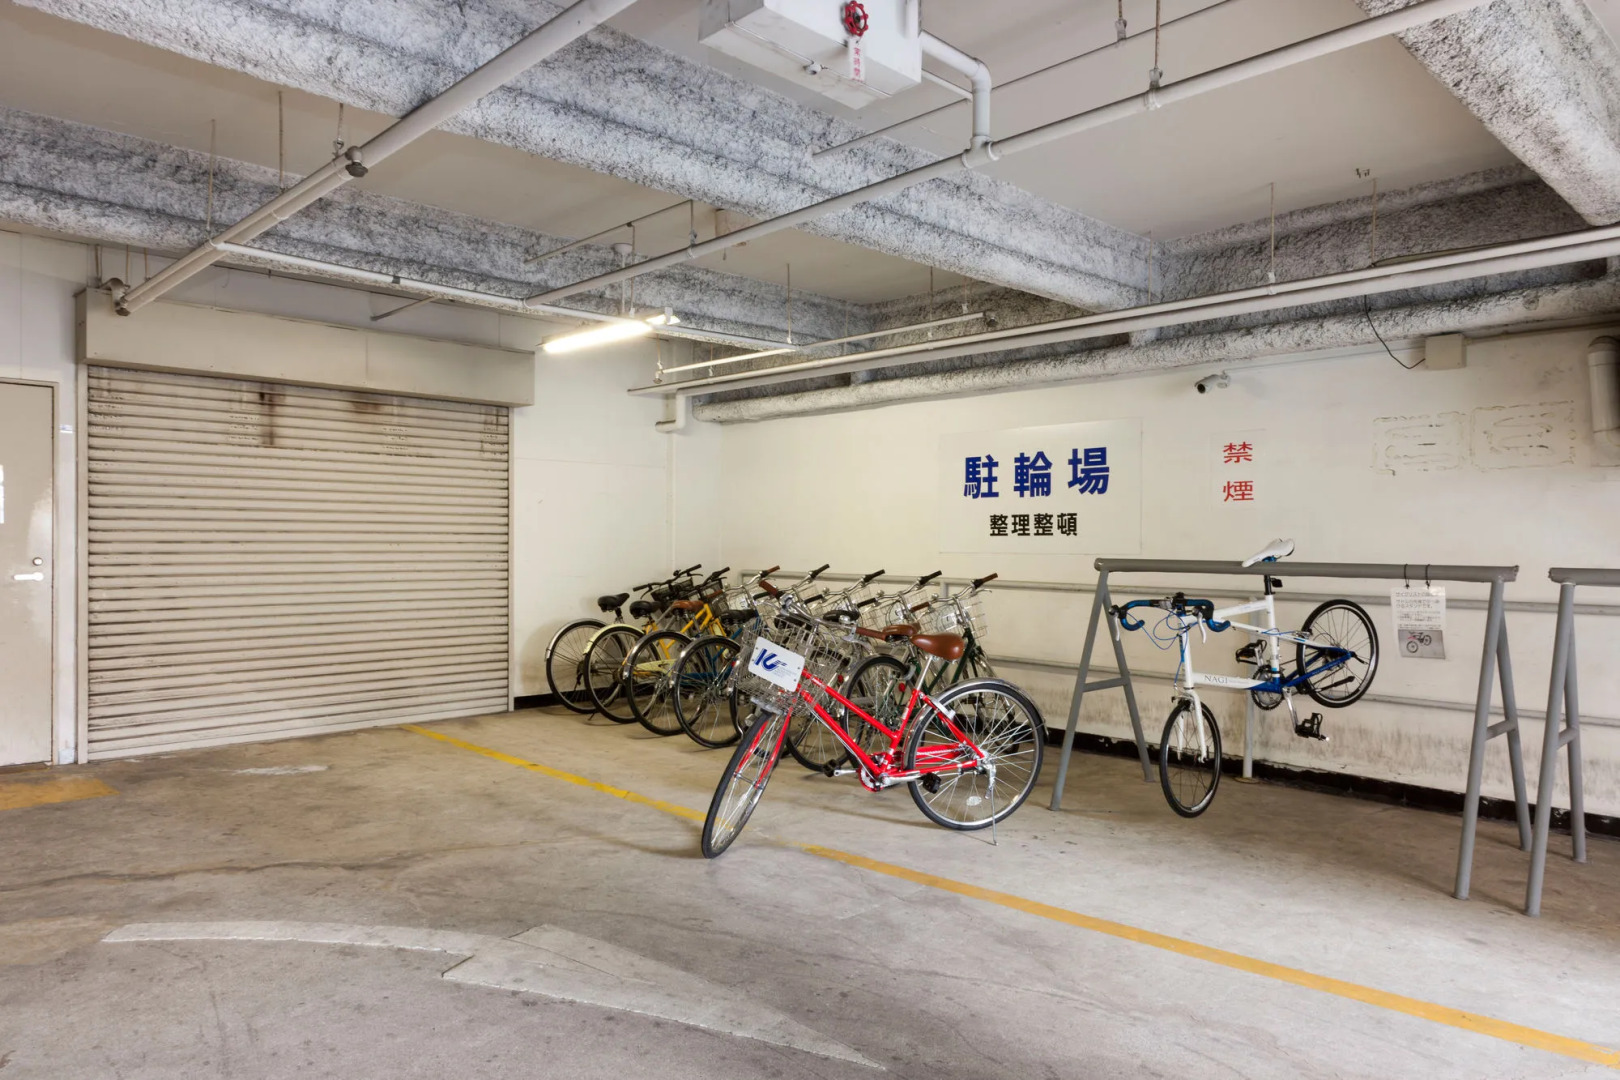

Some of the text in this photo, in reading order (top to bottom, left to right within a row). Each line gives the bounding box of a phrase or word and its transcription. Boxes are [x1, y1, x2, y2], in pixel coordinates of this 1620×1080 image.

[963, 446, 1110, 499] 駐輪場
[1222, 441, 1255, 503] 禁煙
[989, 512, 1078, 537] 整理整頓
[1204, 675, 1228, 684] NAGI
